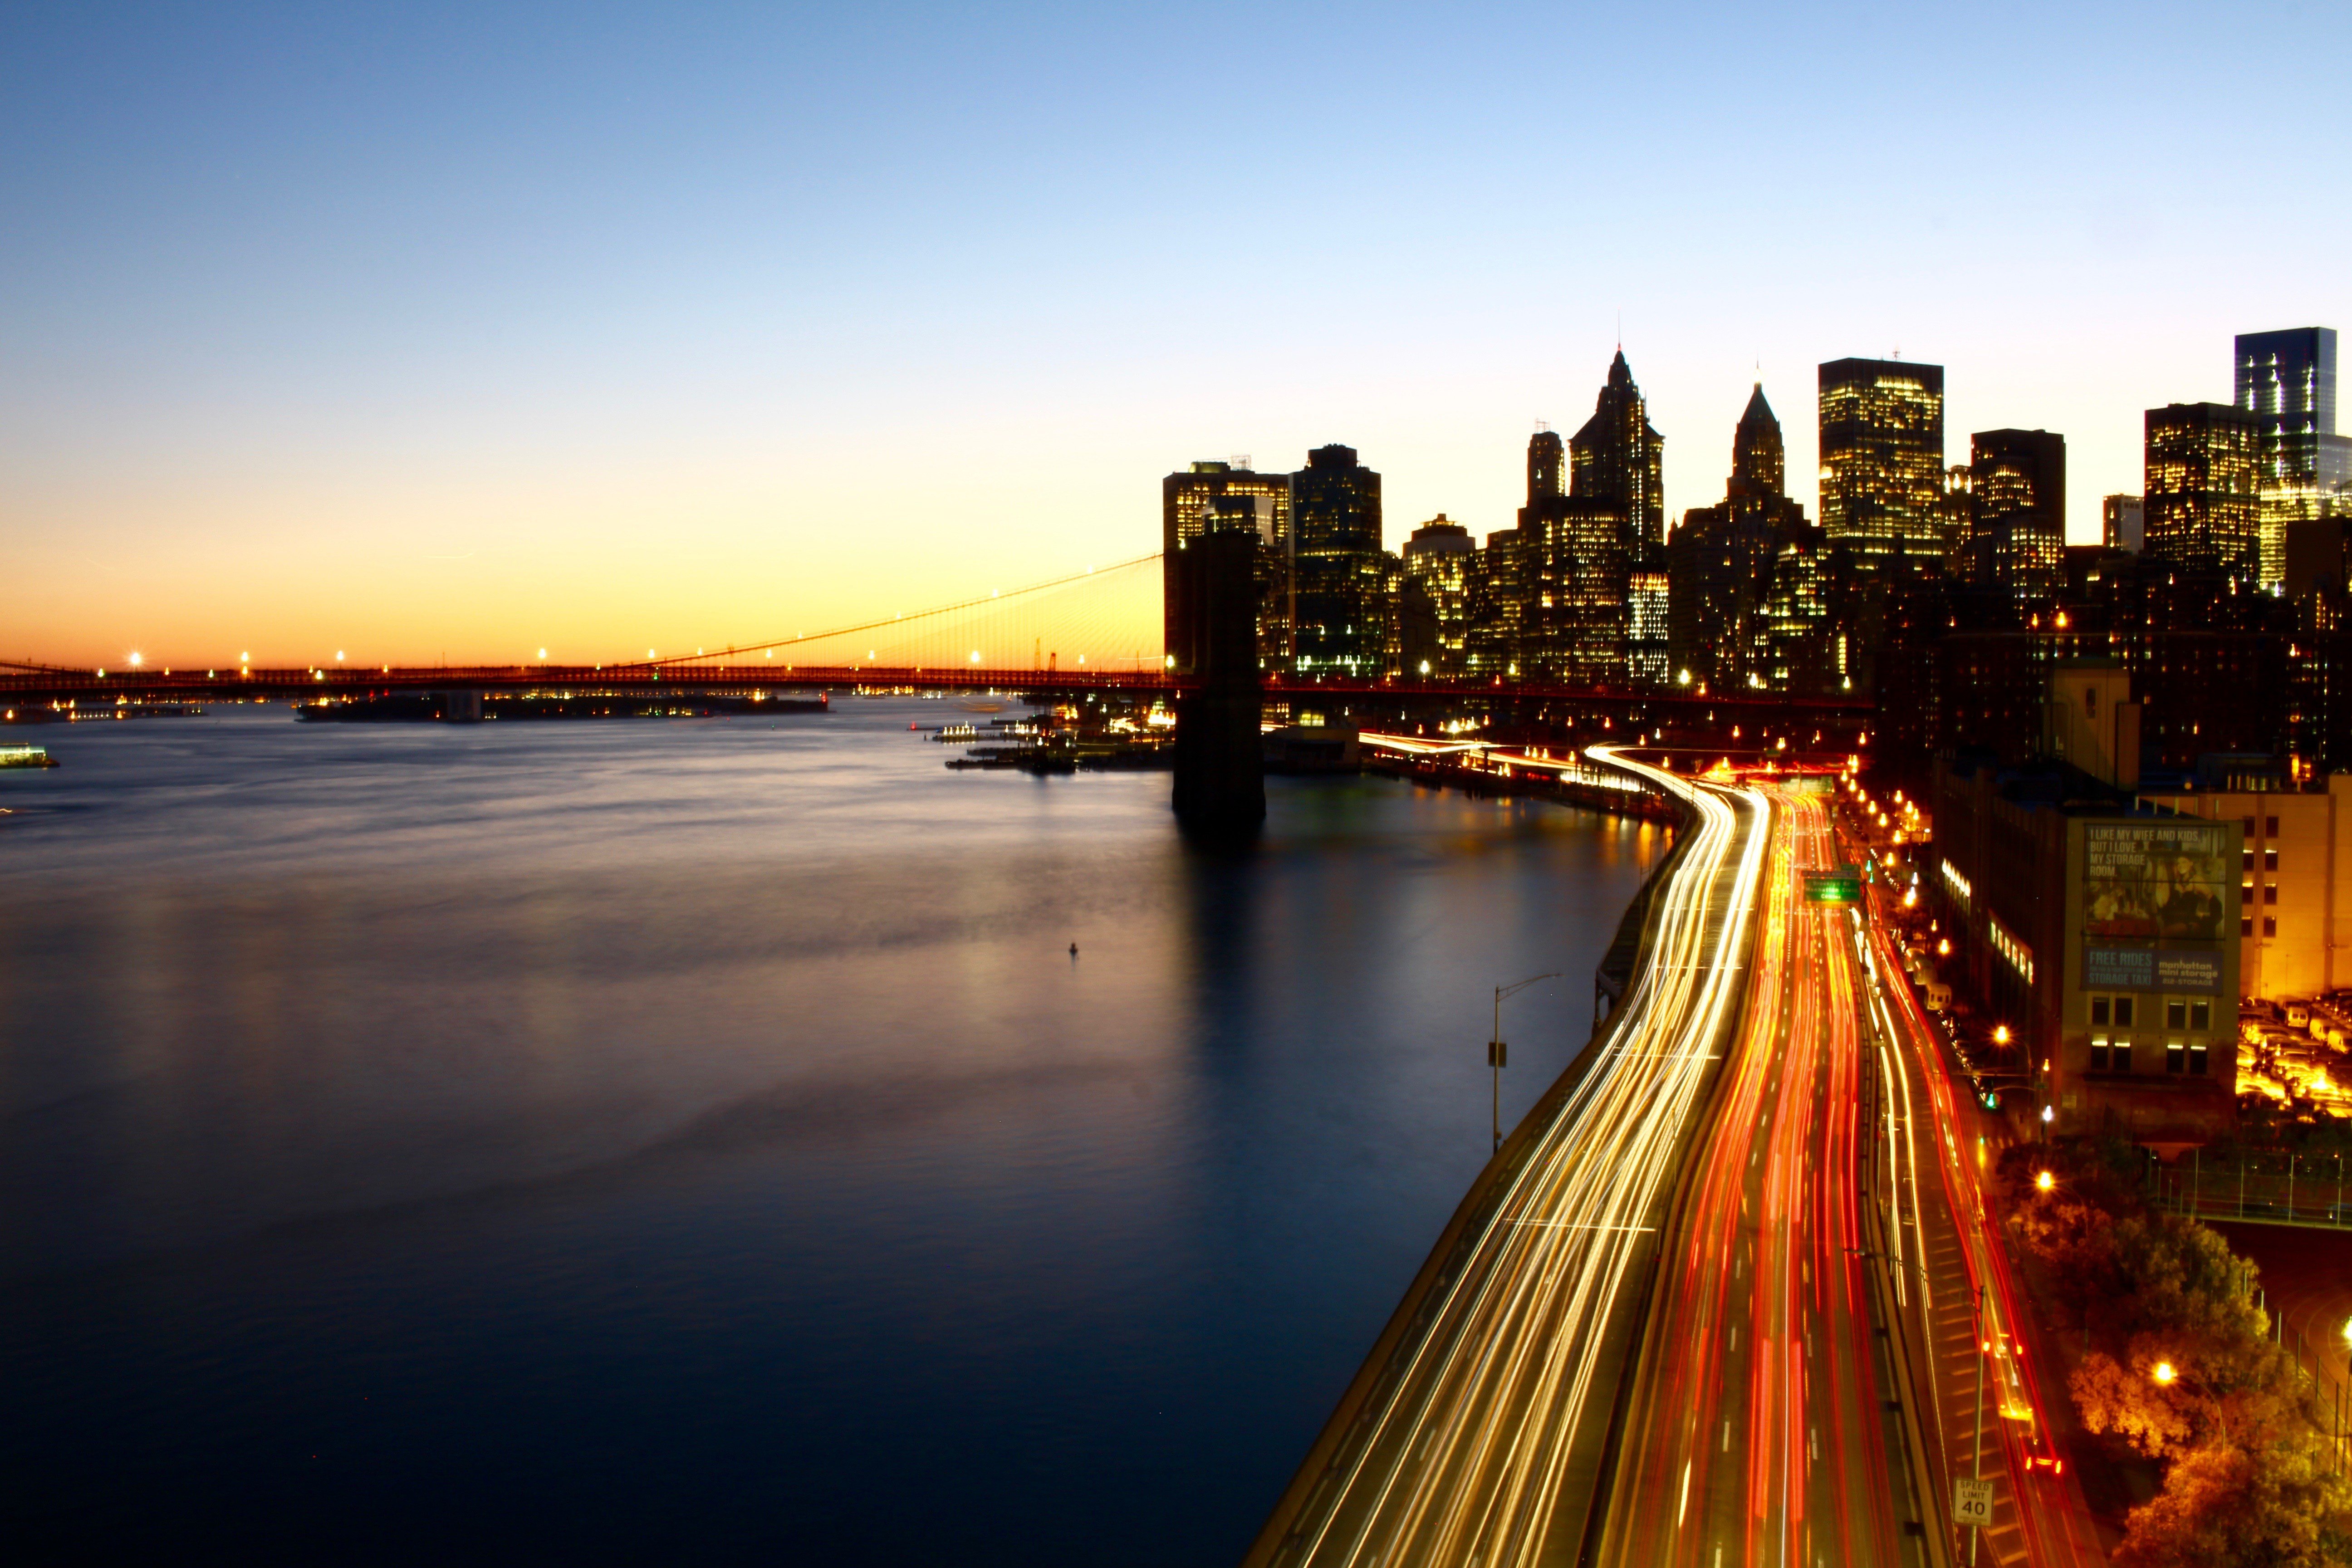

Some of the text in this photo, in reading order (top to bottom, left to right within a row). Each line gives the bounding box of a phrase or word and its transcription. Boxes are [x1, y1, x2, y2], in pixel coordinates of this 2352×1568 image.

[2090, 829, 2094, 839] I
[2095, 829, 2115, 840] LIKE
[2117, 830, 2132, 840] MY
[2133, 830, 2155, 841] WIFE
[2157, 830, 2177, 841] AND
[2090, 841, 2136, 853] BUT I LOVE
[2090, 853, 2146, 865] MY STORAGE
[2090, 866, 2117, 877] ROOM.
[2090, 951, 2152, 966] FREE RIDES
[2159, 959, 2212, 970] manhattan
[2089, 973, 2129, 985] STORAGE
[2180, 970, 2218, 979] storage
[1960, 1480, 1989, 1491] SPEED
[1962, 1490, 1985, 1499] LIMIT
[1961, 1500, 1985, 1515] 40
